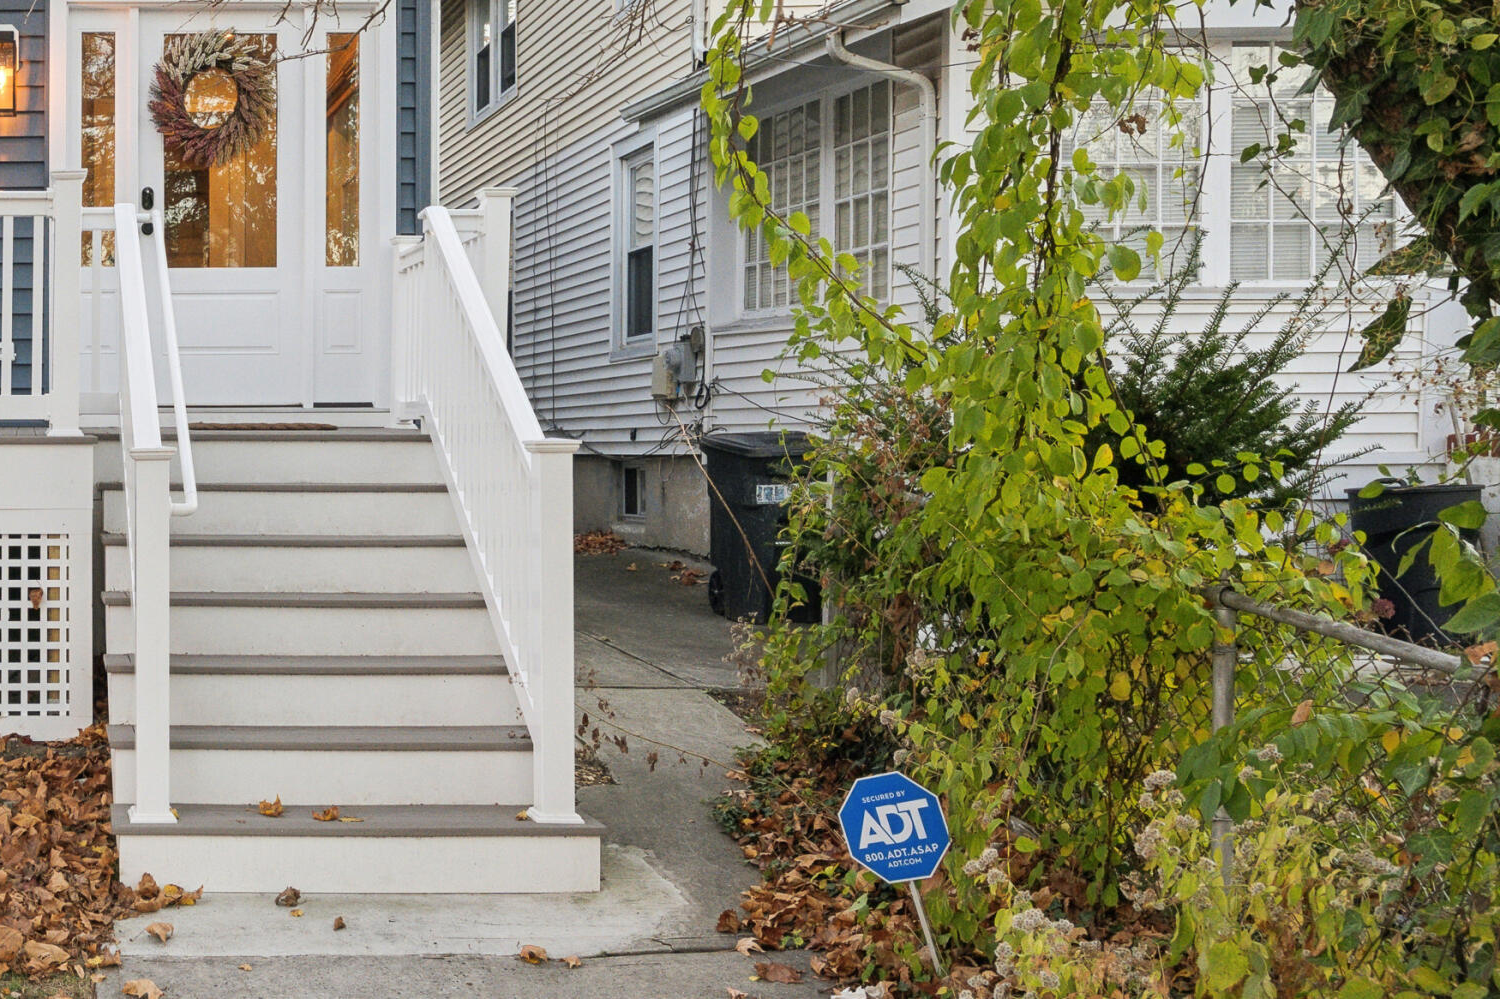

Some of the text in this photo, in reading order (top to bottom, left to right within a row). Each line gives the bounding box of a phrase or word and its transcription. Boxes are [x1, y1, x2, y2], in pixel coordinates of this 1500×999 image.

[861, 792, 895, 804] SECURED
[859, 798, 929, 850] ADT
[864, 843, 939, 863] 800.ADT.ASAP
[888, 857, 923, 868] ADT.COM
